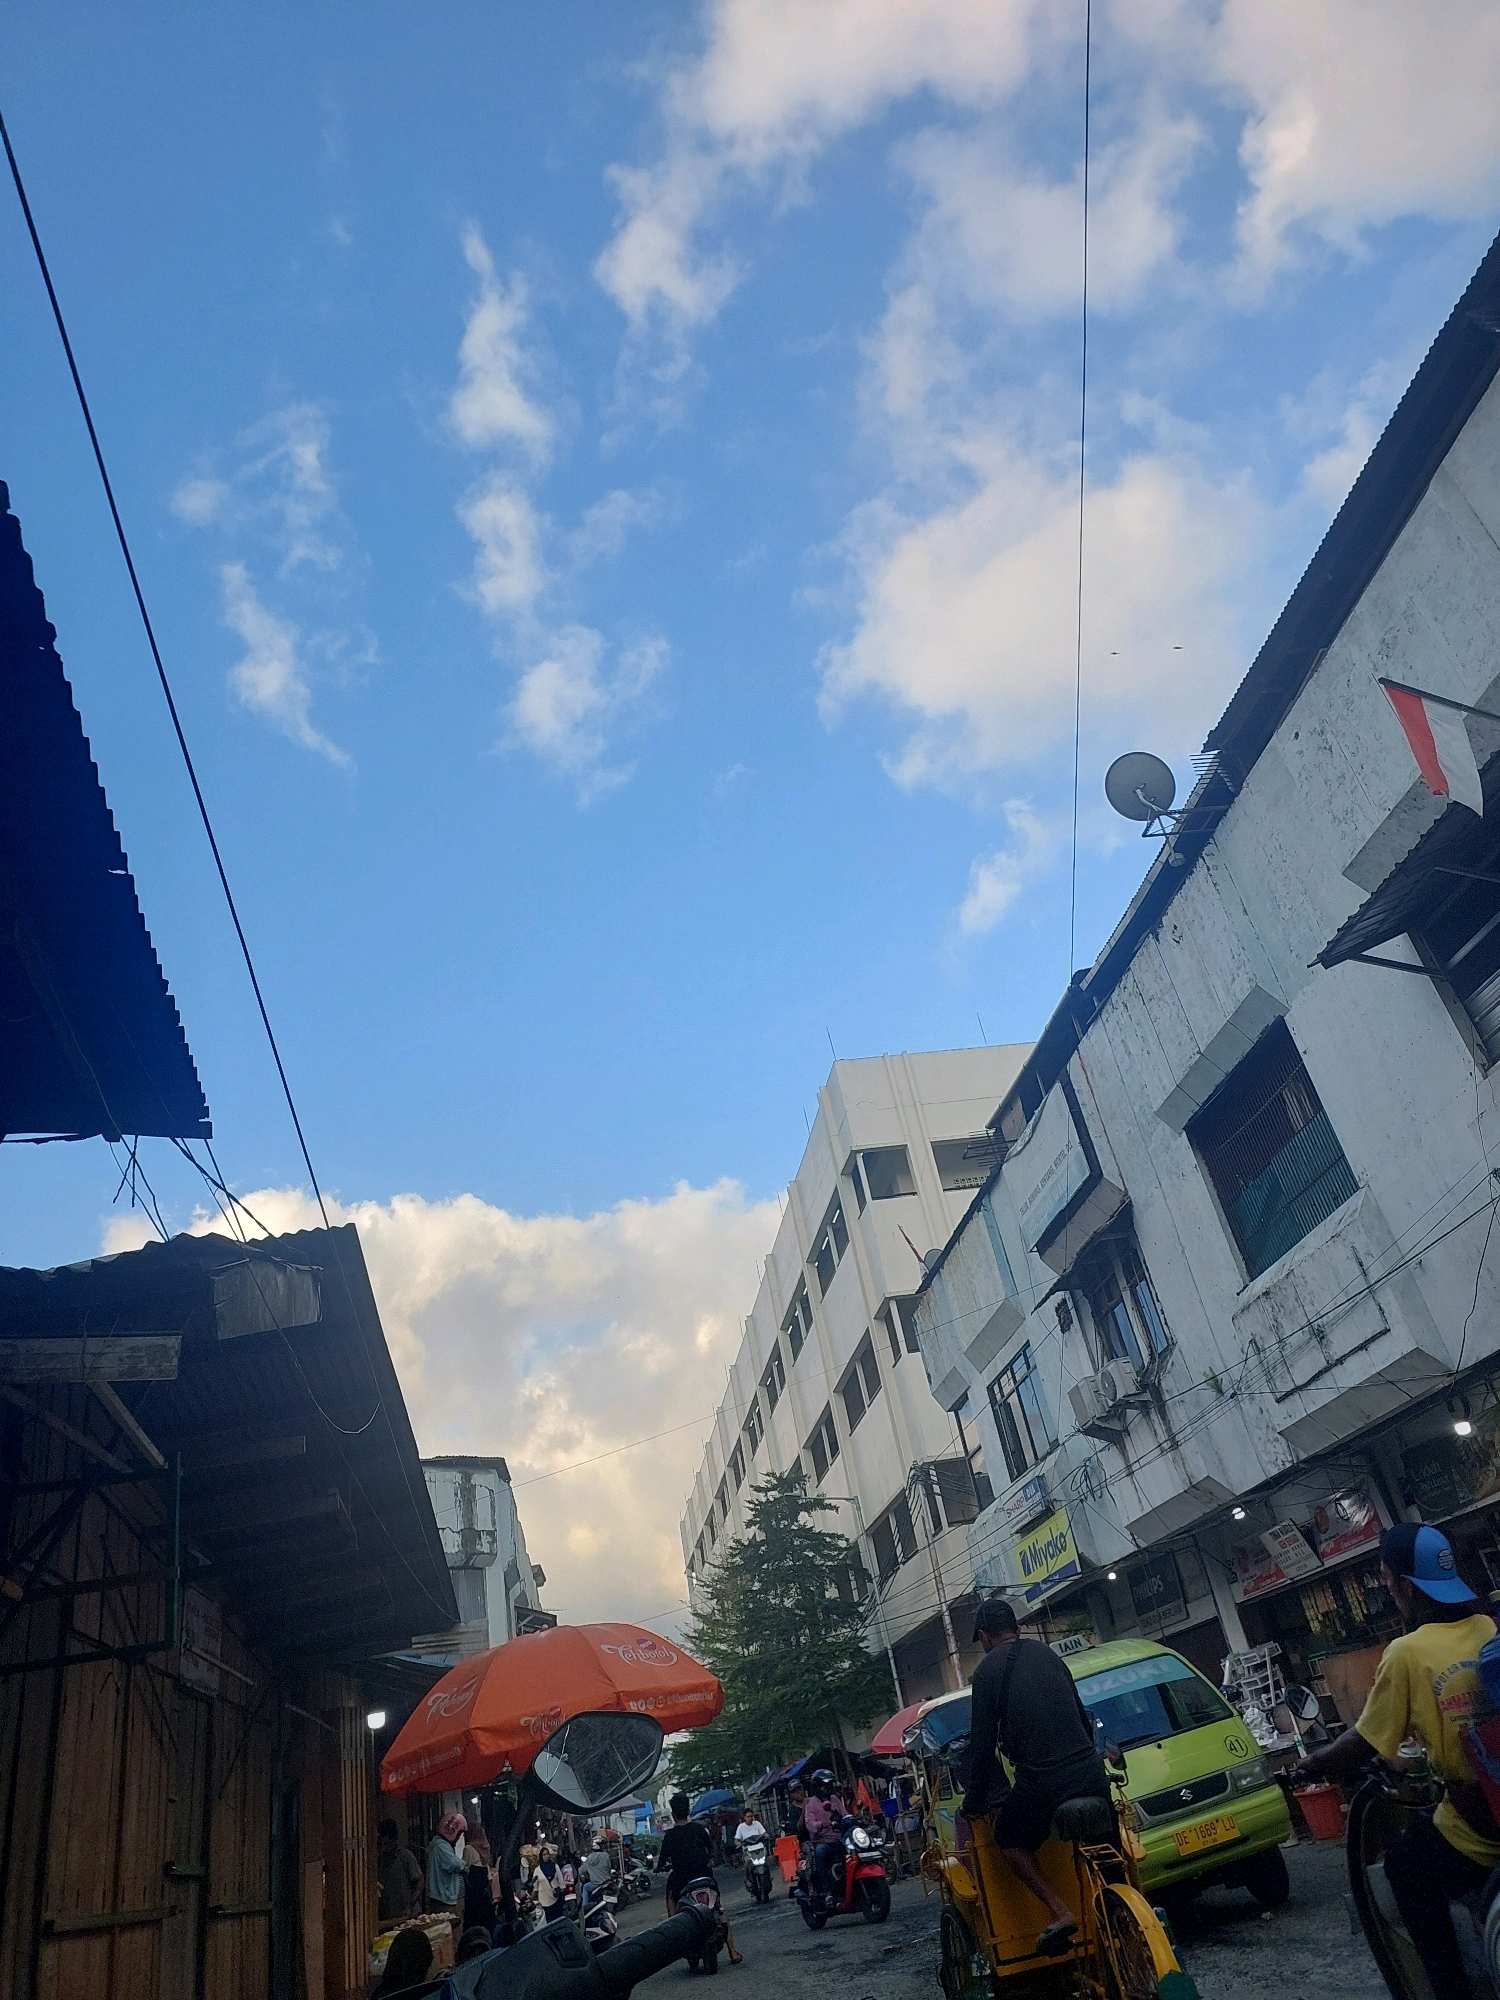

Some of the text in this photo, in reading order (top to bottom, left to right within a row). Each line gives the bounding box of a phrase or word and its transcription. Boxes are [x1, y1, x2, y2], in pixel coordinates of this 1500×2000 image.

[1005, 1496, 1025, 1518] SHARP
[1028, 1526, 1068, 1574] Miyako
[1058, 1638, 1083, 1654] IAIN
[1228, 1738, 1245, 1754] 41
[1175, 1829, 1191, 1847] DE
[1193, 1821, 1219, 1840] 1669
[1220, 1815, 1236, 1832] LU
